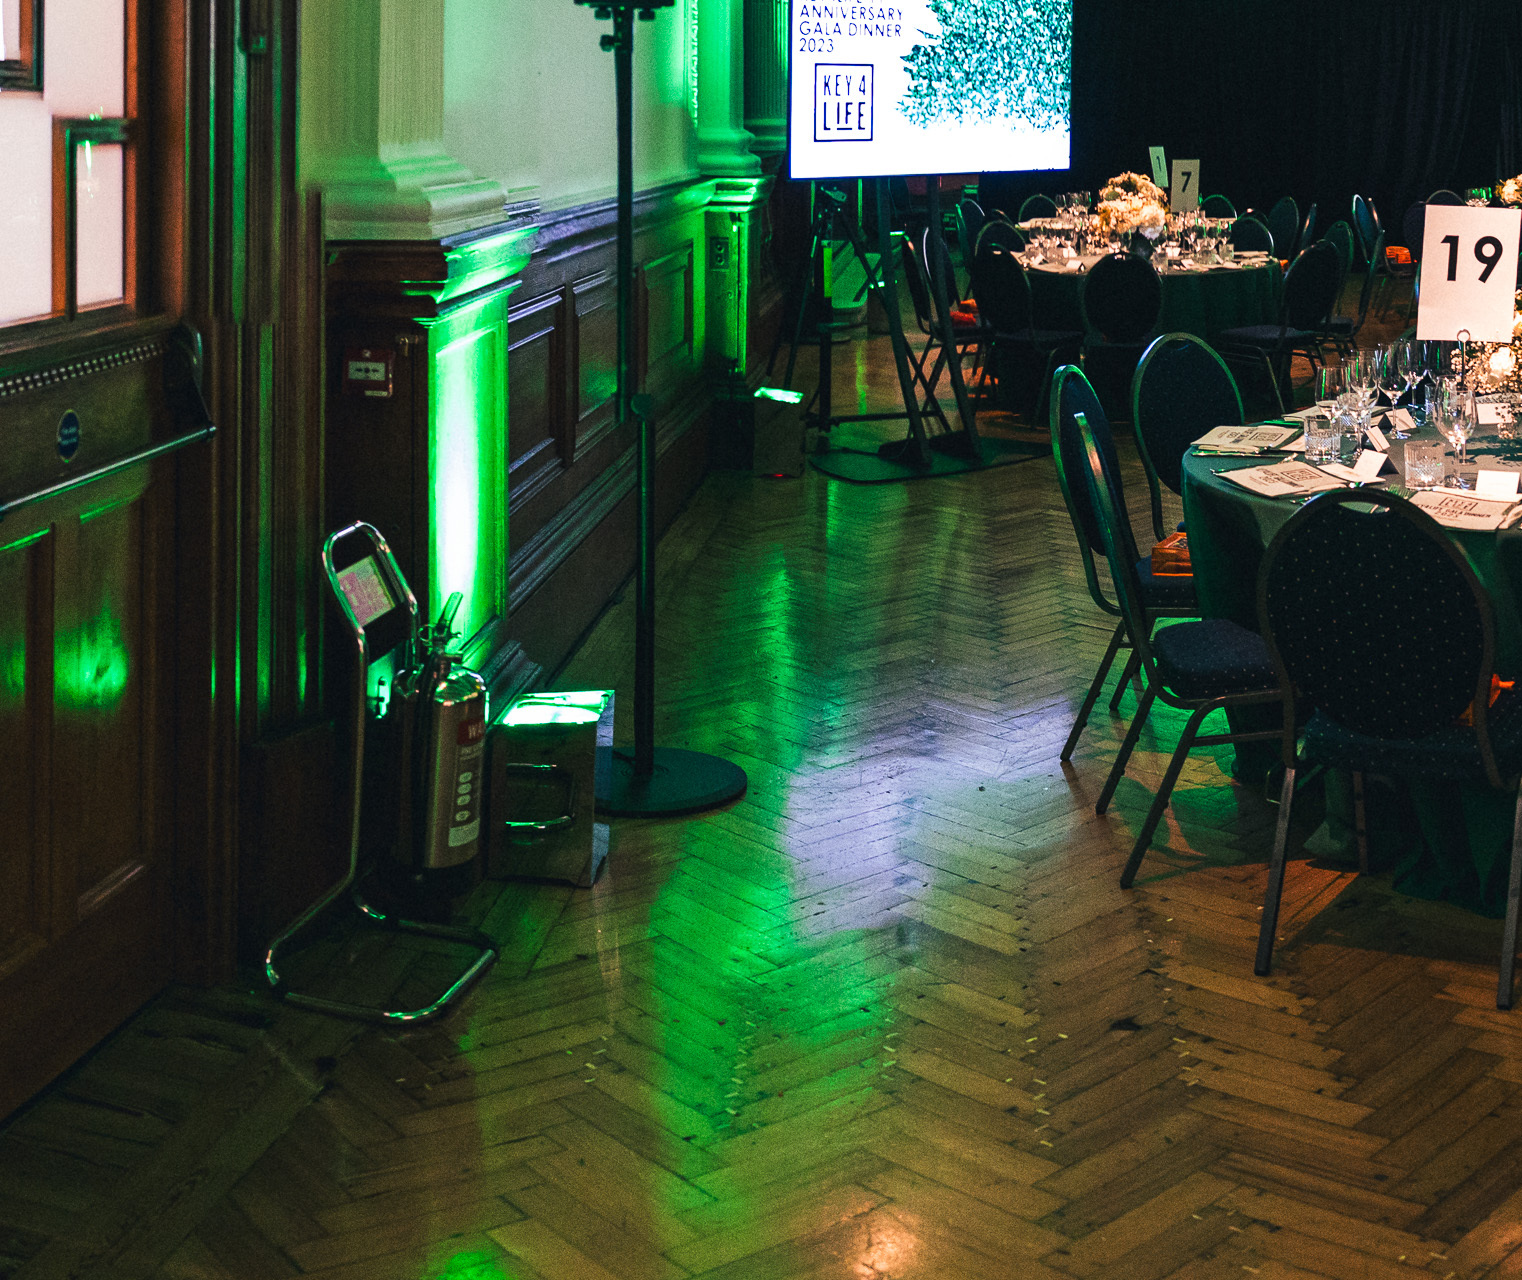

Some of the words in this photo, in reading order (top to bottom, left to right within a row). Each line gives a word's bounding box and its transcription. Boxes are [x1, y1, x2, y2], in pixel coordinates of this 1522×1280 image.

[800, 4, 903, 21] ANNIVERSARY
[799, 20, 842, 36] GALA
[848, 22, 902, 38] DINNER
[799, 37, 834, 53] 2023
[823, 74, 852, 97] KEY
[858, 74, 866, 96] 4
[823, 101, 866, 131] LIFE
[1181, 171, 1192, 193] 7
[1440, 234, 1504, 284] 19
